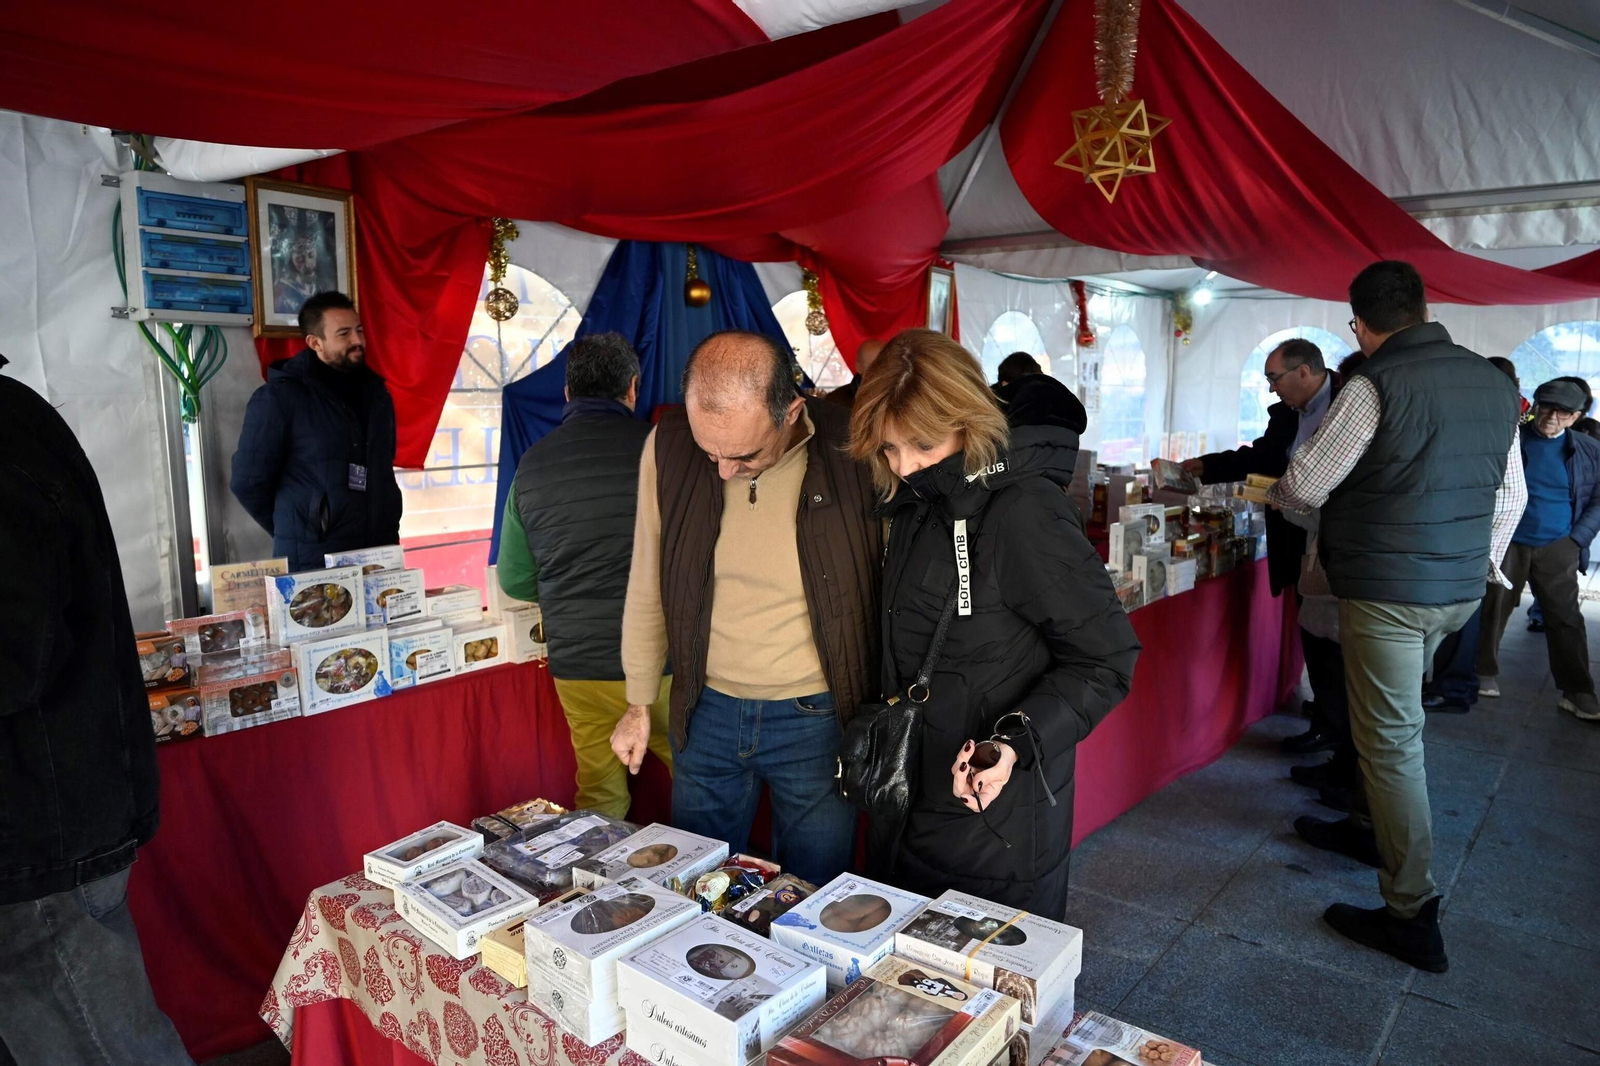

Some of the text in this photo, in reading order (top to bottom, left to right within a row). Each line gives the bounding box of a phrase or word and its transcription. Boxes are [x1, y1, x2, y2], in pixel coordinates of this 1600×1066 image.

[221, 567, 280, 581] CARMELITAS
[228, 579, 266, 591] DESCAL
[725, 930, 746, 945] Clara
[745, 941, 754, 949] de
[753, 945, 761, 953] la
[765, 948, 796, 969] Columna
[802, 941, 834, 960] Galletas
[642, 999, 708, 1049] Dulces artesanos
